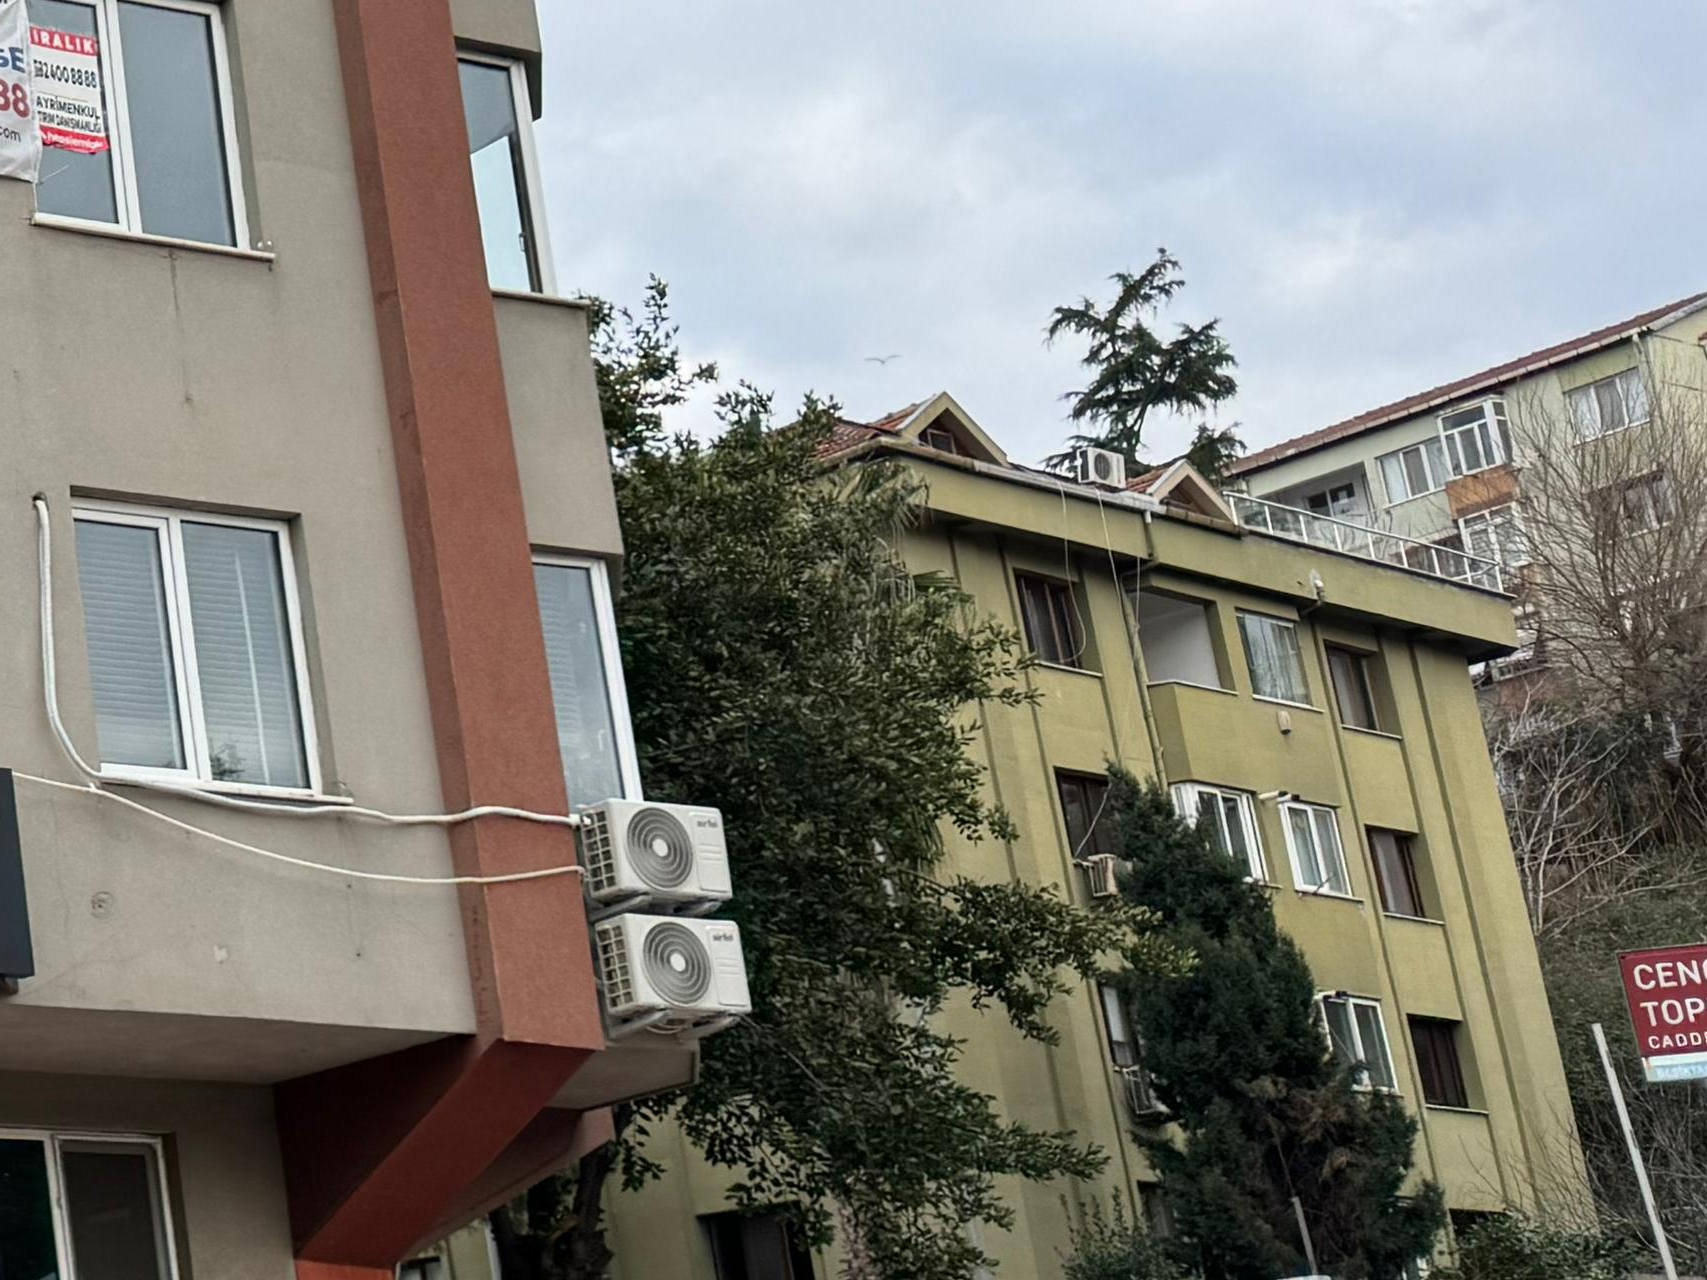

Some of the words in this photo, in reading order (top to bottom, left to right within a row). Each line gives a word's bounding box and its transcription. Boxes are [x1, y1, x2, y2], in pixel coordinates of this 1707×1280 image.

[30, 28, 94, 55] IRALIK
[36, 95, 101, 122] AYRİMENKUL
[1633, 959, 1707, 991] CEN
[1639, 997, 1707, 1027] TOP
